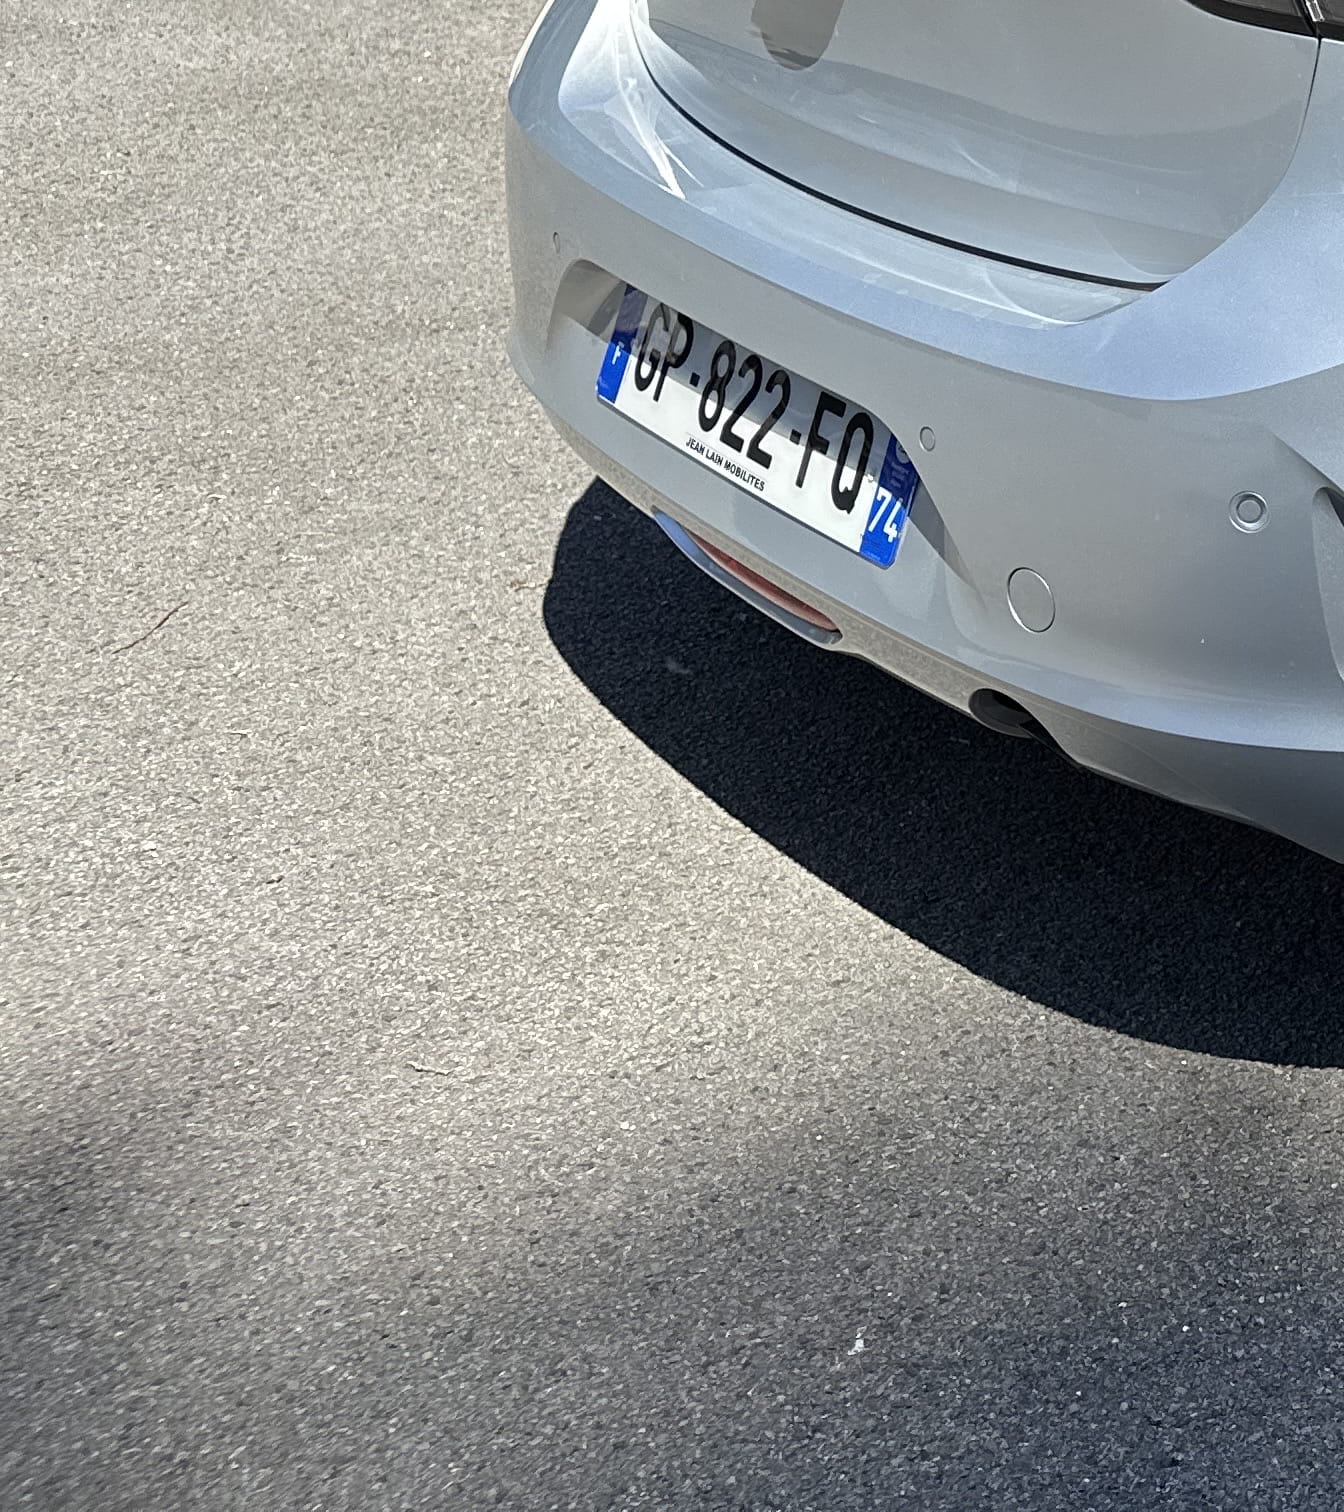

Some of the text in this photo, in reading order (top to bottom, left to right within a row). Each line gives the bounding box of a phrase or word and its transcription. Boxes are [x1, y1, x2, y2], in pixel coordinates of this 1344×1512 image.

[634, 302, 874, 515] GP-822-FQ
[724, 460, 765, 491] MOBILITES
[868, 486, 903, 543] 74
